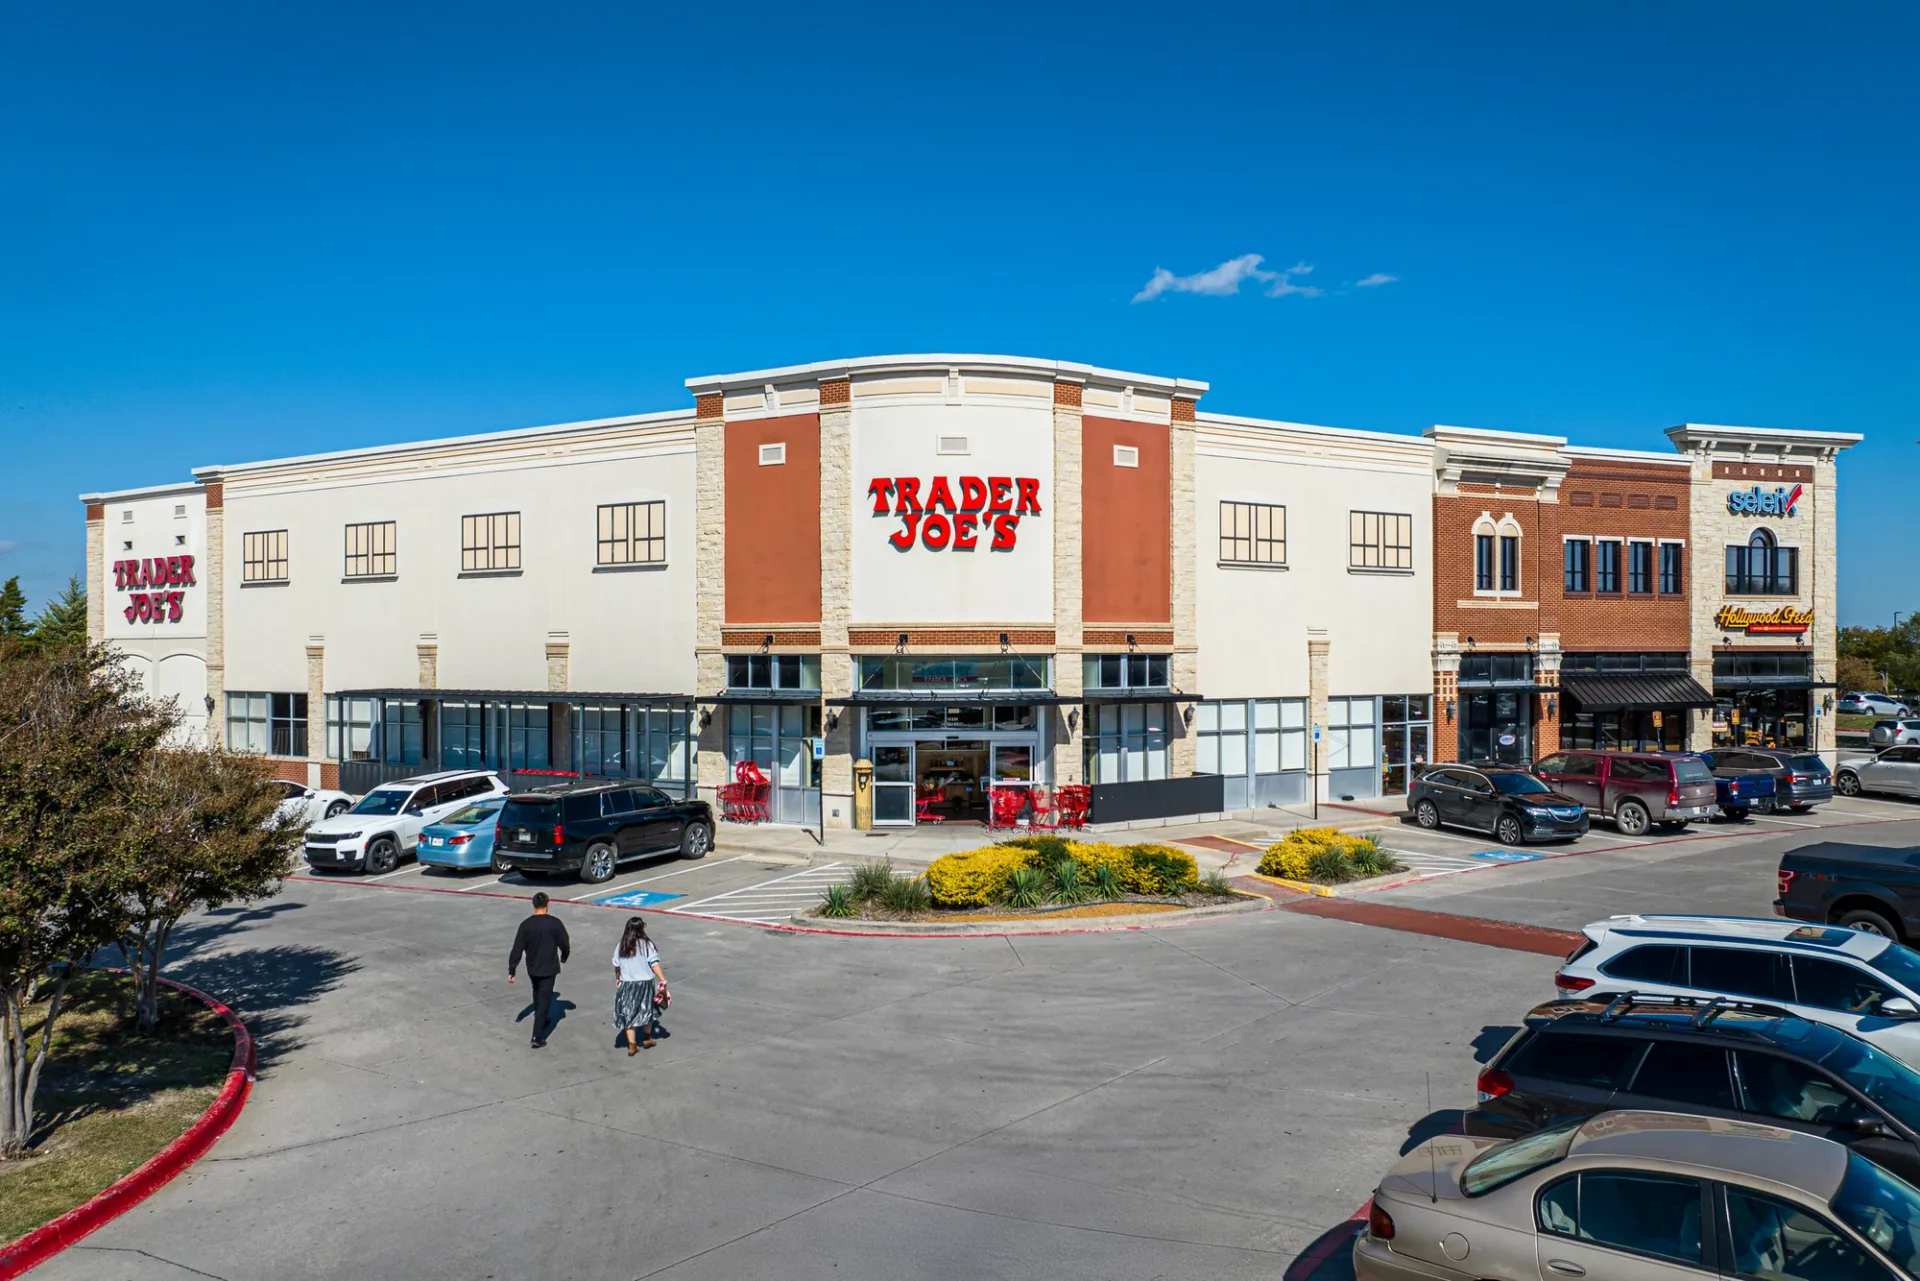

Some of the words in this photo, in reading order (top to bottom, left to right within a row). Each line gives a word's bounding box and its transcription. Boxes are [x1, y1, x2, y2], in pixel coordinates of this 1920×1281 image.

[867, 476, 1042, 517] TRADER
[889, 512, 1020, 552] JOE'S
[113, 555, 196, 590] TRADER
[123, 591, 185, 624] JOE'S
[1719, 605, 1780, 627] Hollywood
[1780, 606, 1814, 624] Feed
